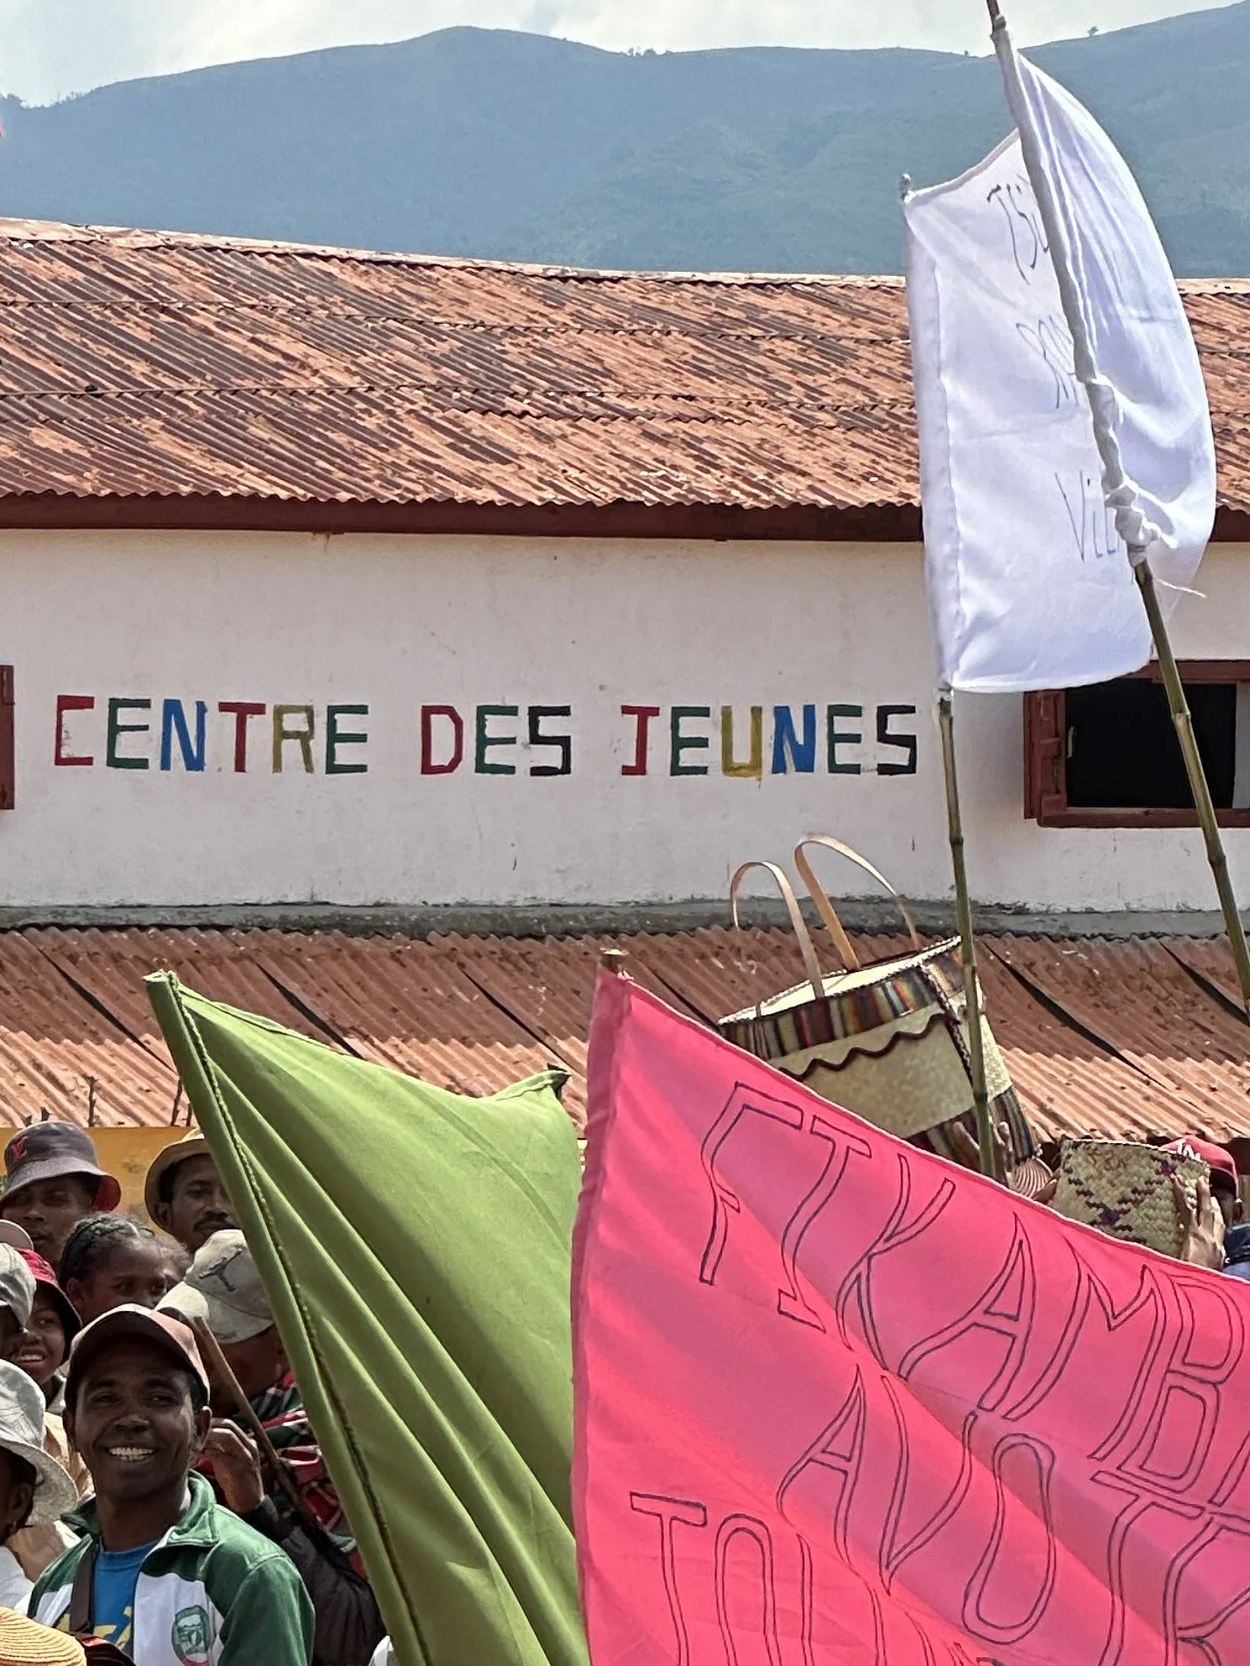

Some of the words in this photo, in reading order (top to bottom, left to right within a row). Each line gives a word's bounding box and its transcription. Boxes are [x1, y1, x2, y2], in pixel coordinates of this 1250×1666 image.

[54, 695, 369, 775] CENTRE
[420, 704, 572, 777] DES
[620, 704, 917, 780] JEUNES
[700, 1080, 1250, 1508] FIKAMB
